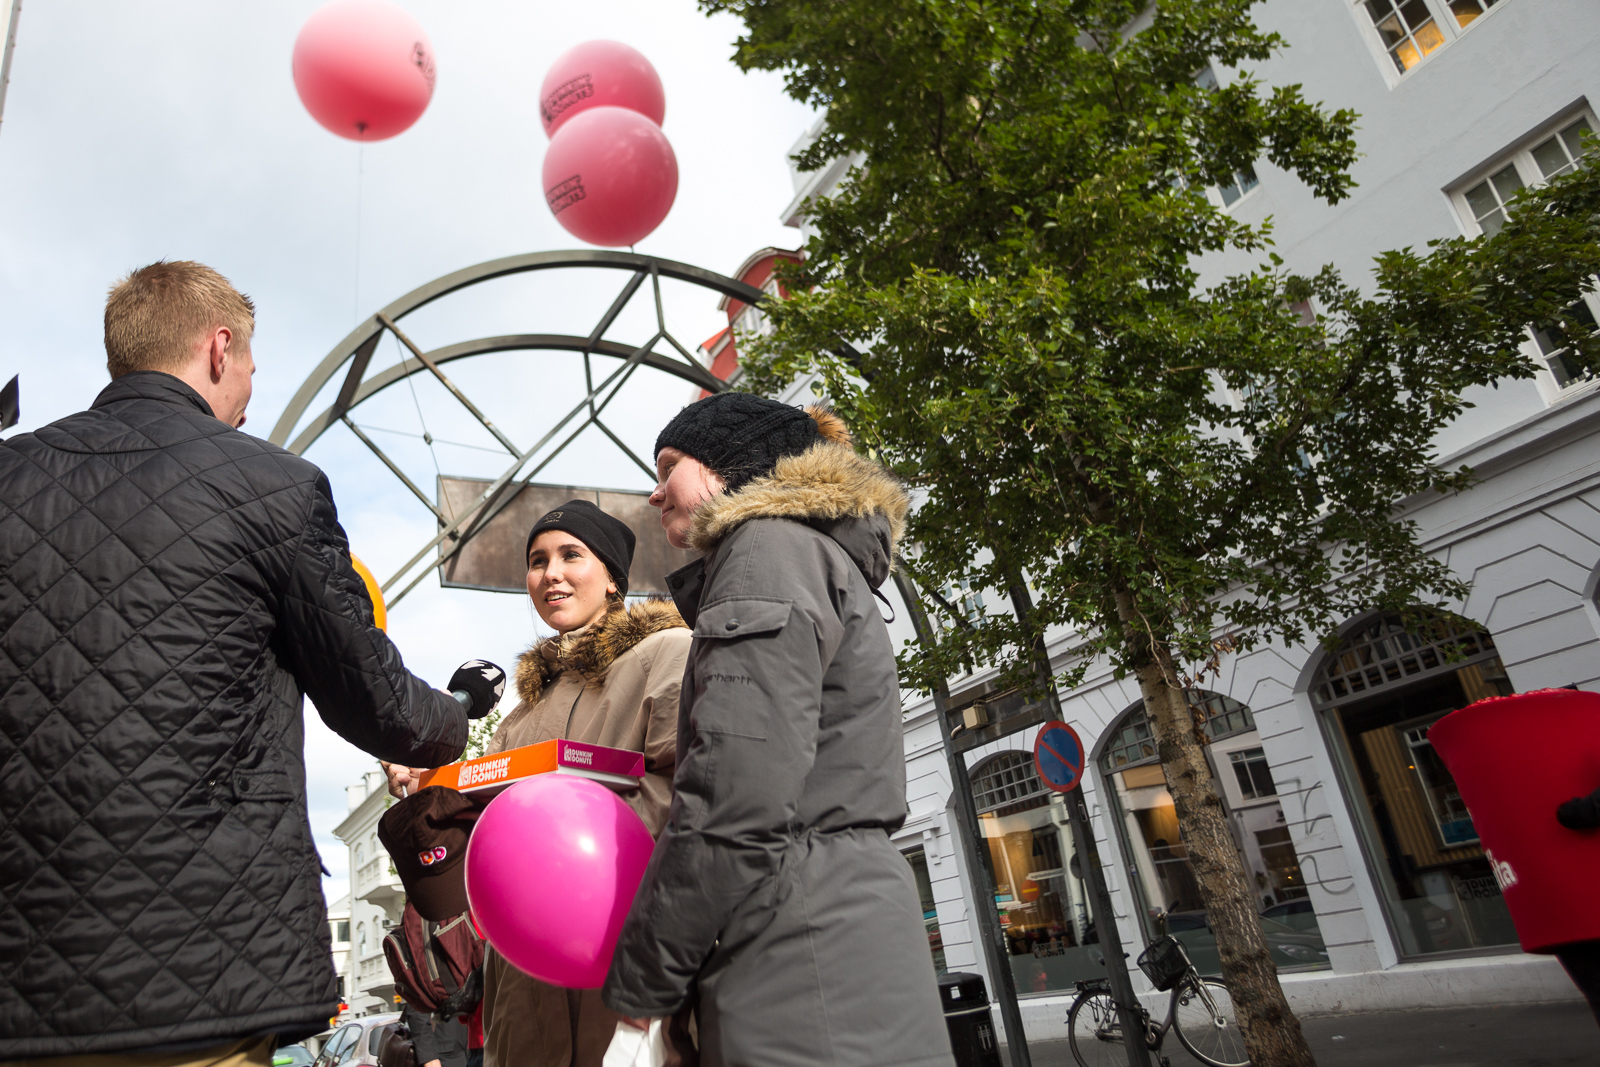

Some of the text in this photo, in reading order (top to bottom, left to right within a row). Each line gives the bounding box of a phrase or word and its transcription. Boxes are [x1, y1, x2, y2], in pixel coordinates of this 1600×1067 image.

[472, 757, 511, 773] DUNKIN'
[571, 756, 592, 765] DONUTS
[471, 767, 508, 784] DONUTS
[419, 846, 447, 865] DD
[1470, 876, 1498, 888] DUN
[1474, 887, 1502, 898] DON
